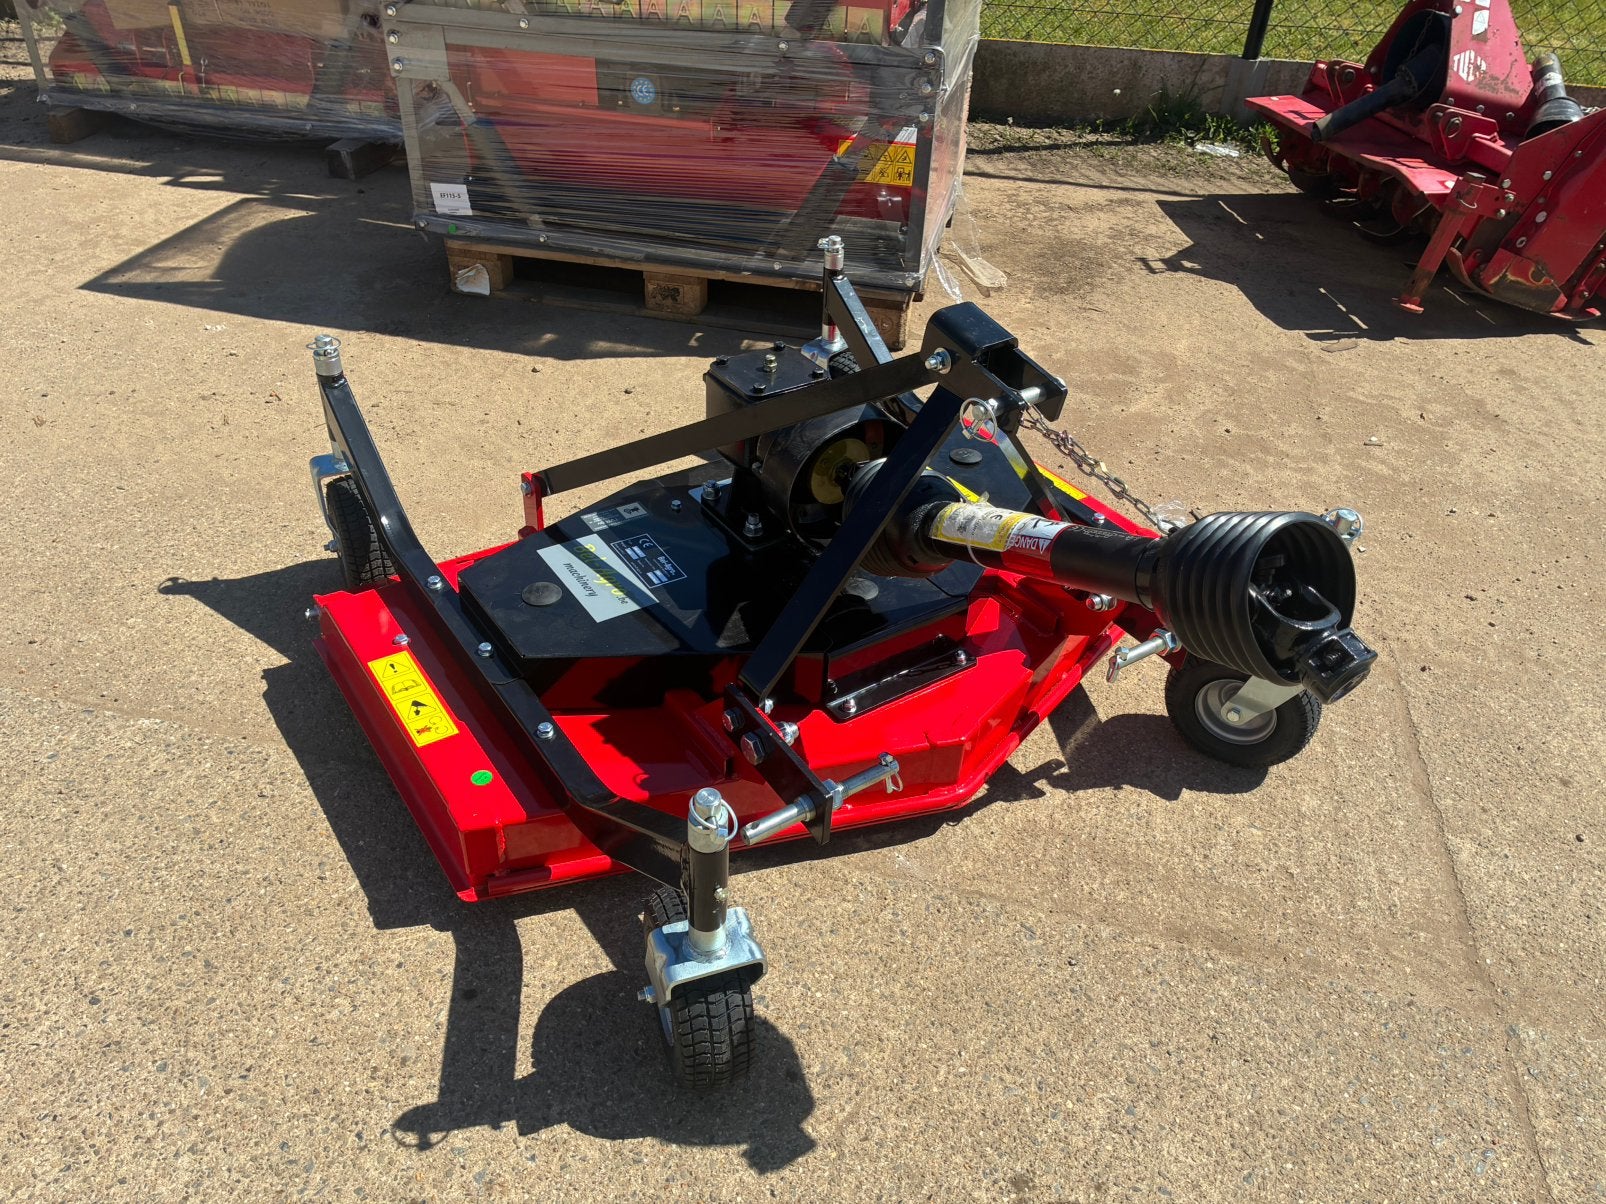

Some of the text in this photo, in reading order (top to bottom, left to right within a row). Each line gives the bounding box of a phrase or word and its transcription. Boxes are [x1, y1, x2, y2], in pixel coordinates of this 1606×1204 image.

[639, 538, 653, 548] CE
[1005, 533, 1039, 550] DANGE
[562, 562, 599, 598] machinery
